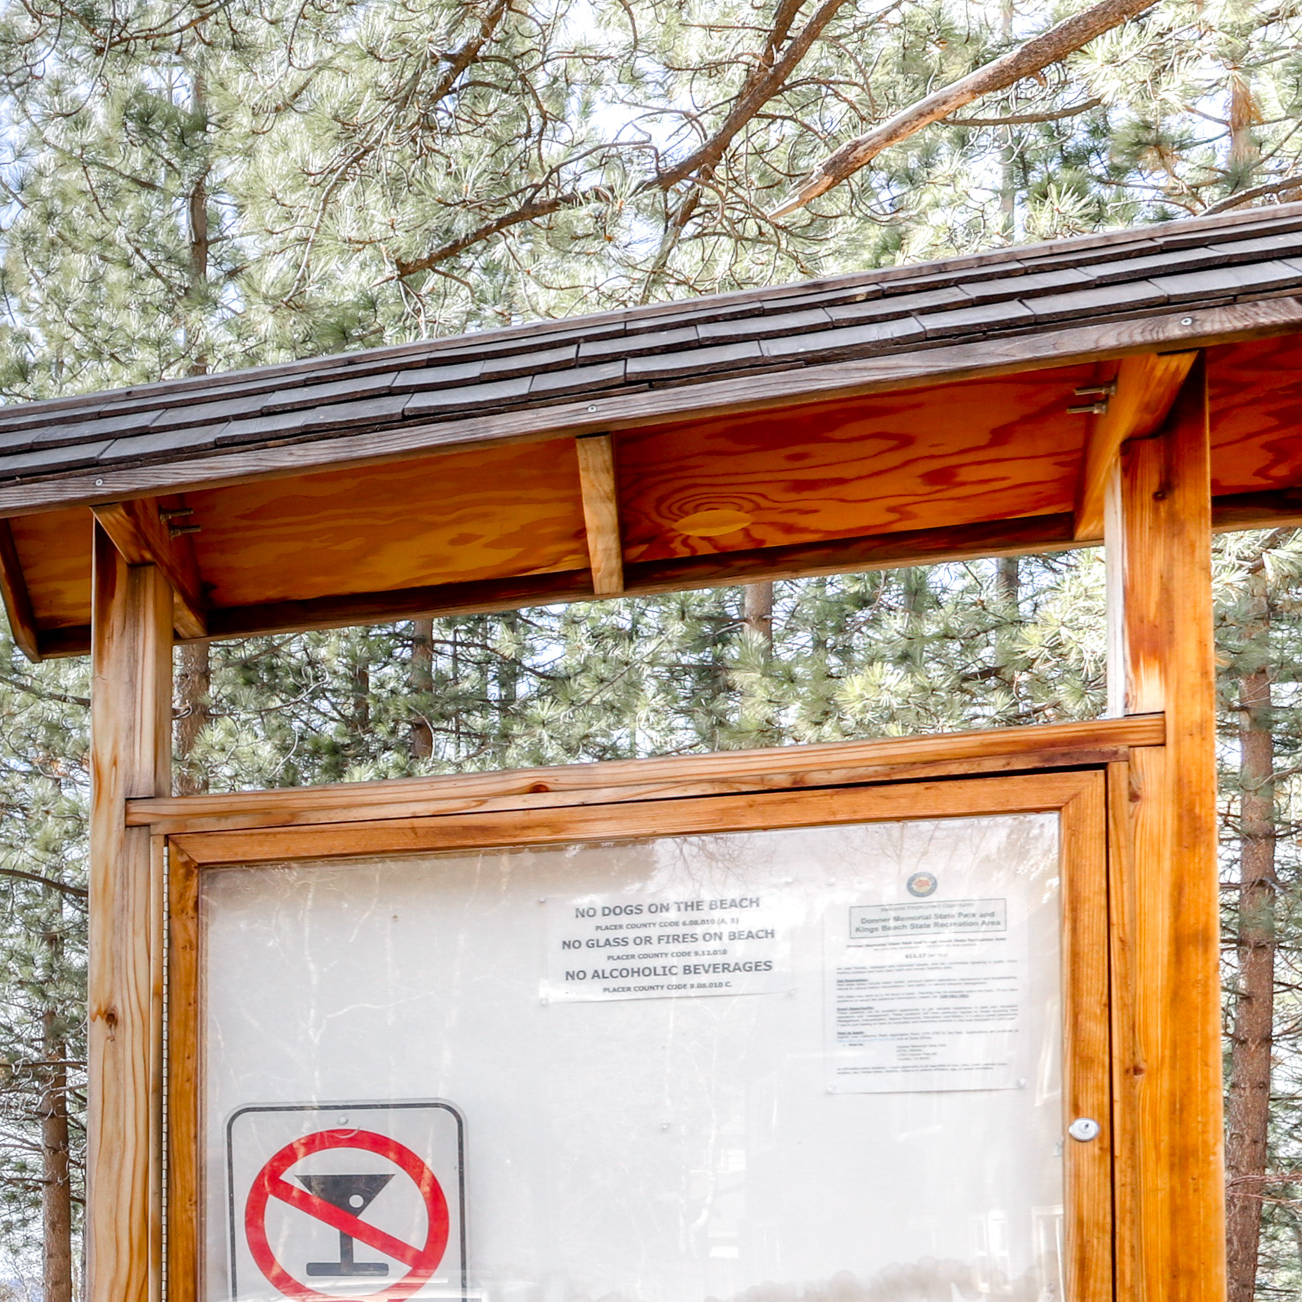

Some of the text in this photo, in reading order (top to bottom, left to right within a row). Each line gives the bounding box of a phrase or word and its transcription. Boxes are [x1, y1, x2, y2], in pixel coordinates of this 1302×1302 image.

[575, 897, 760, 918] NO DOGS ON THE BEACH
[893, 913, 932, 922] Memorial
[934, 912, 955, 920] State
[957, 911, 976, 919] Park
[595, 923, 624, 931] PLACER
[626, 921, 657, 930] COUNTY
[658, 920, 680, 928] CODE
[881, 923, 907, 932] Beach
[910, 922, 931, 930] State
[933, 920, 979, 928] Recreation
[981, 919, 1001, 927] Area
[562, 928, 775, 950] NO GLASS OR FIRES ON BEACH
[607, 953, 636, 961] PLACER
[637, 951, 669, 960] COUNTY
[671, 950, 692, 958] CODE
[565, 960, 773, 981] NO ALCOHOLIC BEVERAGES
[633, 984, 664, 992] COUNTY
[666, 983, 688, 991] CODE
